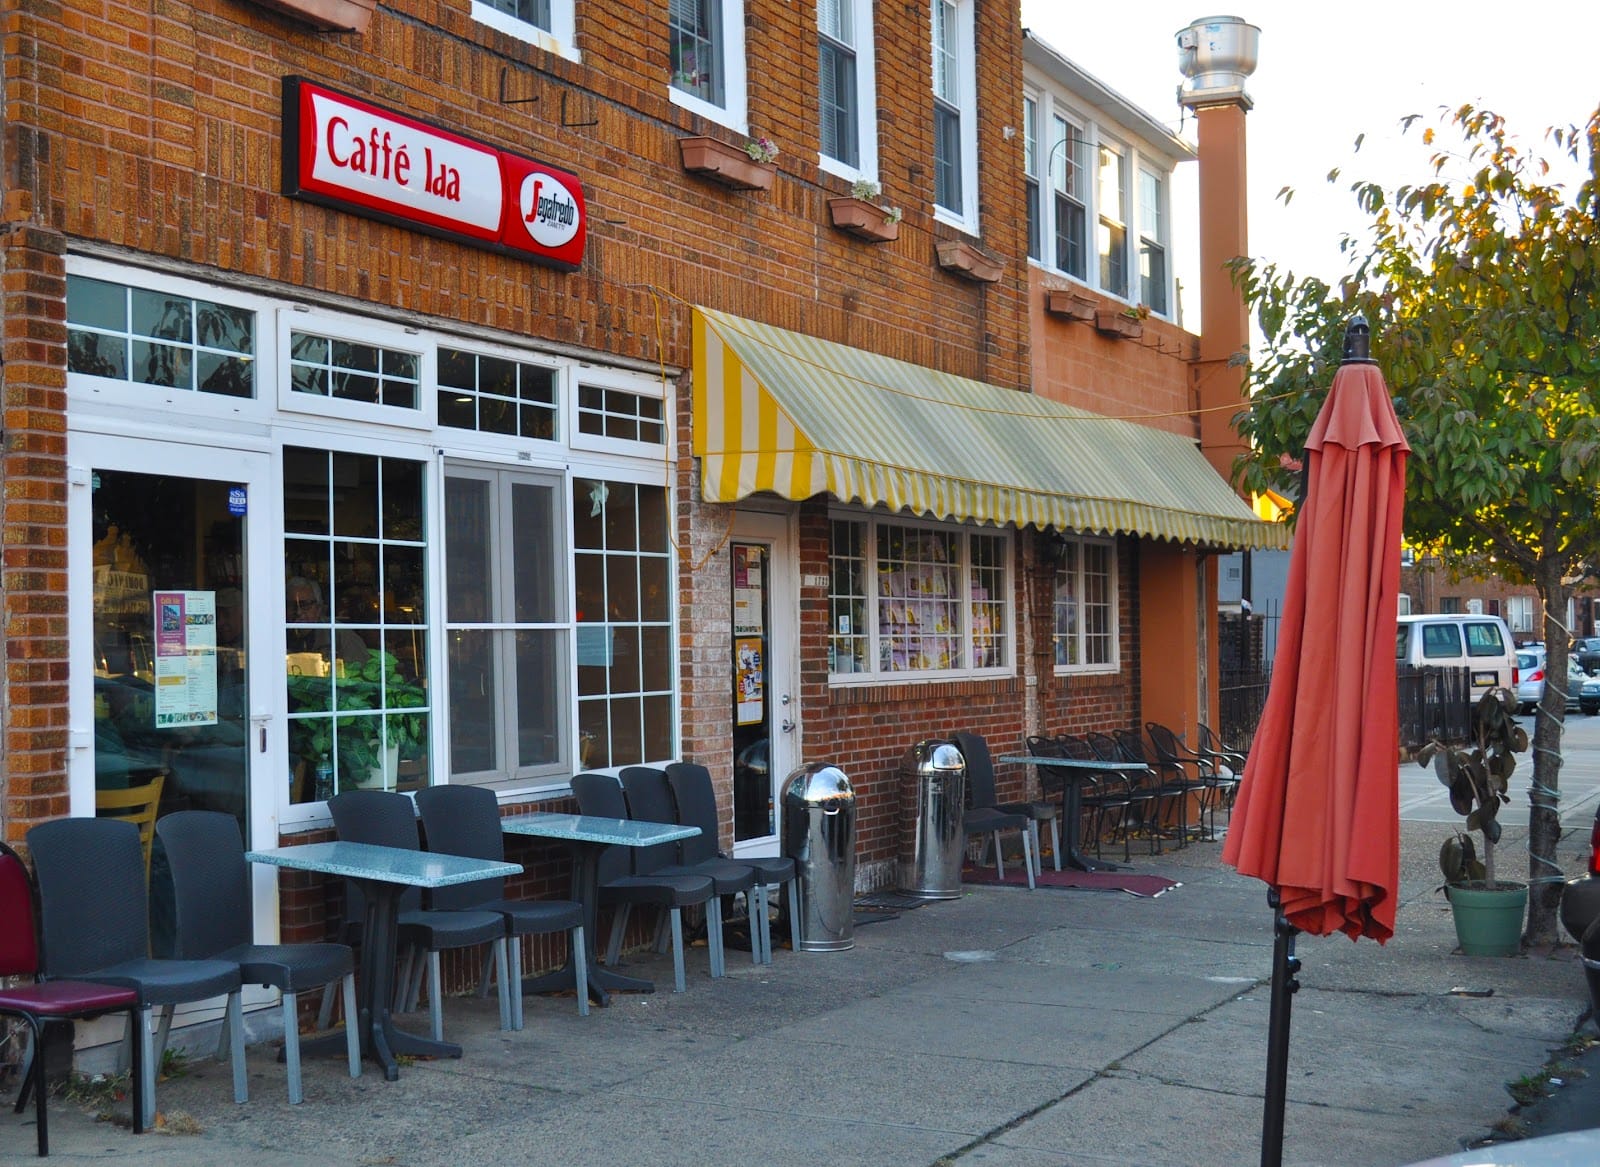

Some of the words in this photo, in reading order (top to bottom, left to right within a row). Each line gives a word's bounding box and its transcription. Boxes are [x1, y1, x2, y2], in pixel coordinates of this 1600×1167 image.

[326, 116, 411, 186] Caffé
[424, 147, 461, 202] Ida
[525, 180, 575, 226] Segafredo
